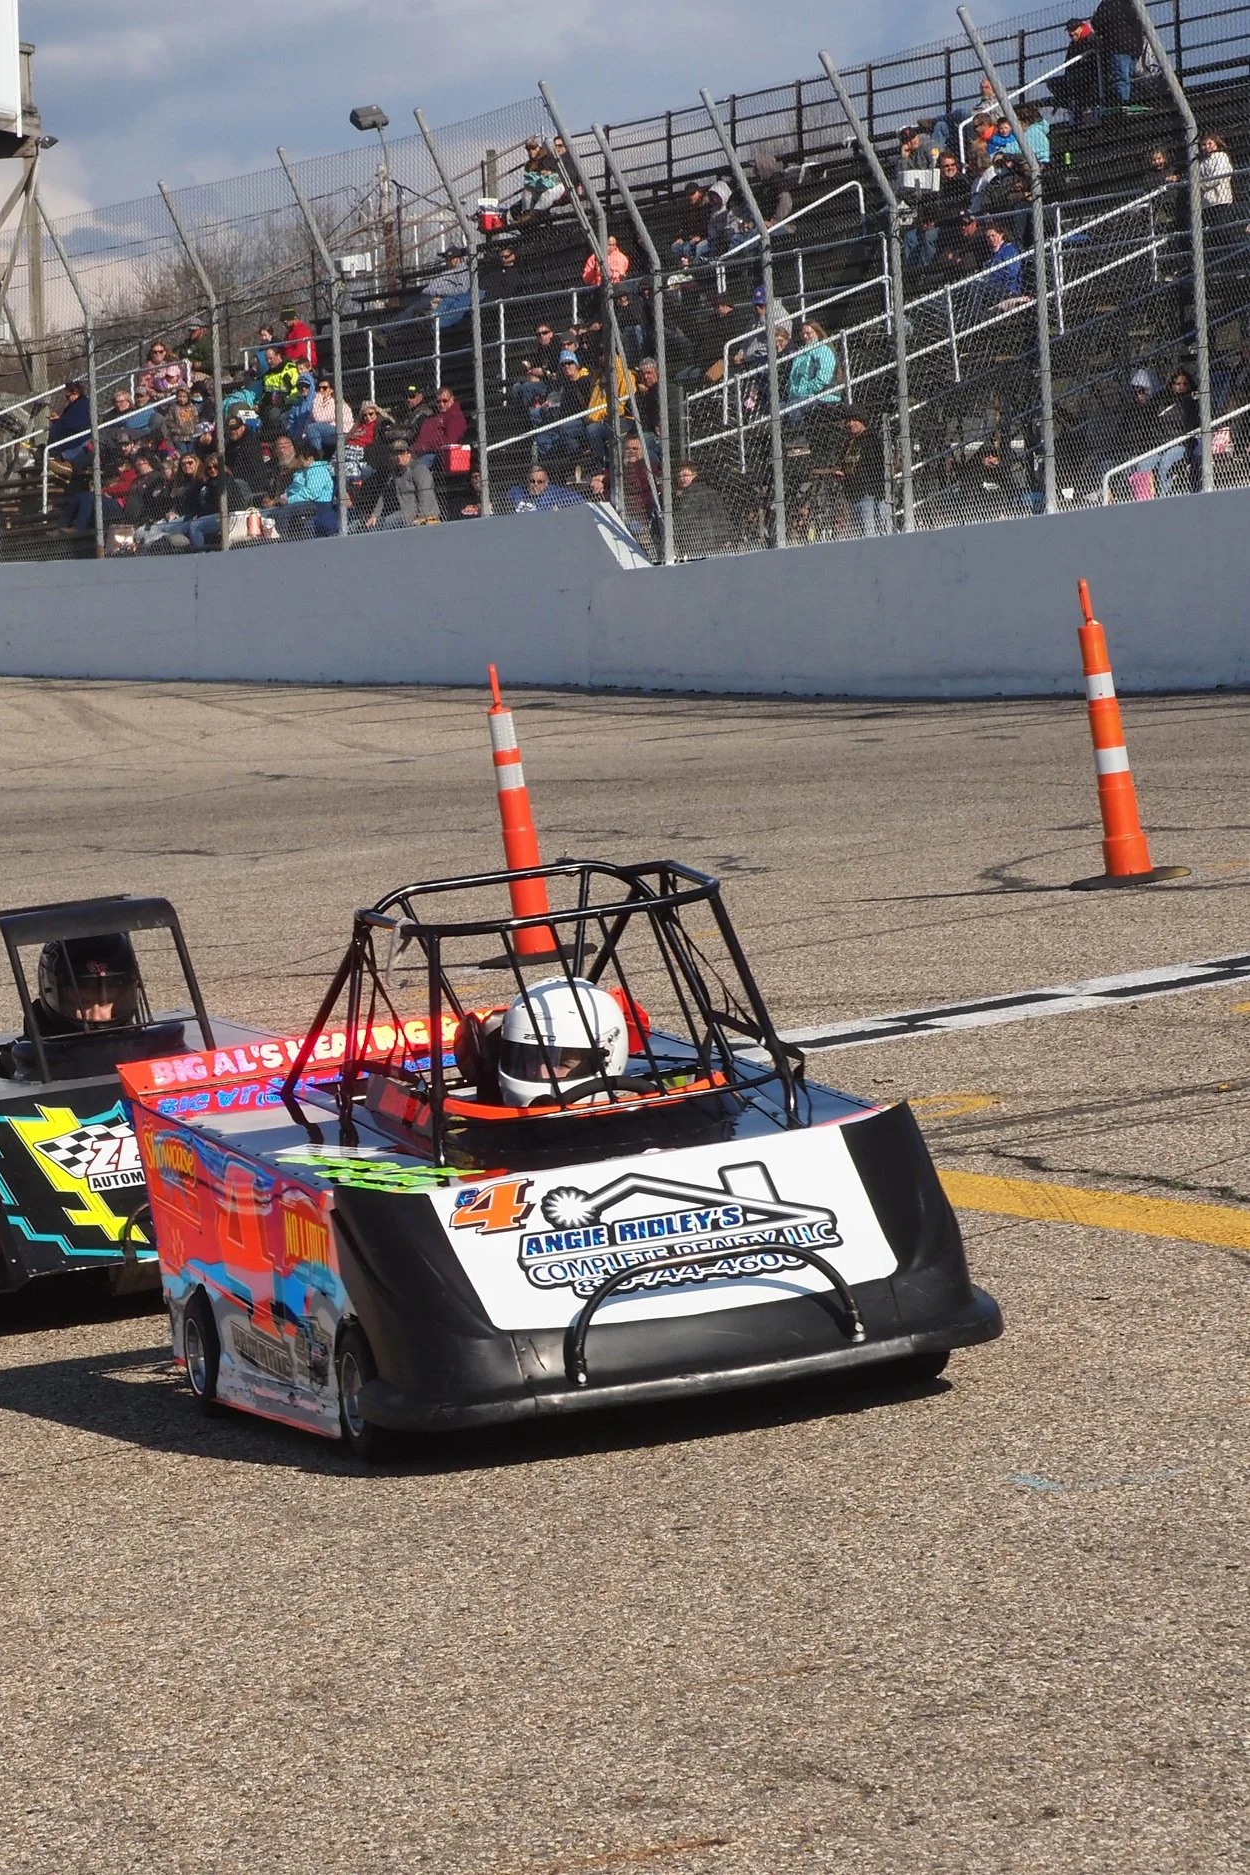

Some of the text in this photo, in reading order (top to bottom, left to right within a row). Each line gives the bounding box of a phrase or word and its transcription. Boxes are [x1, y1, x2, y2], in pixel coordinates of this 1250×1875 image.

[150, 1055, 208, 1086] BIG
[213, 1043, 284, 1077] AL'S
[91, 1171, 146, 1190] AUTOM
[525, 1205, 742, 1256] ANGIE RIDLEY'S
[531, 1248, 667, 1284] COMPLETE
[783, 1221, 837, 1246] LLC
